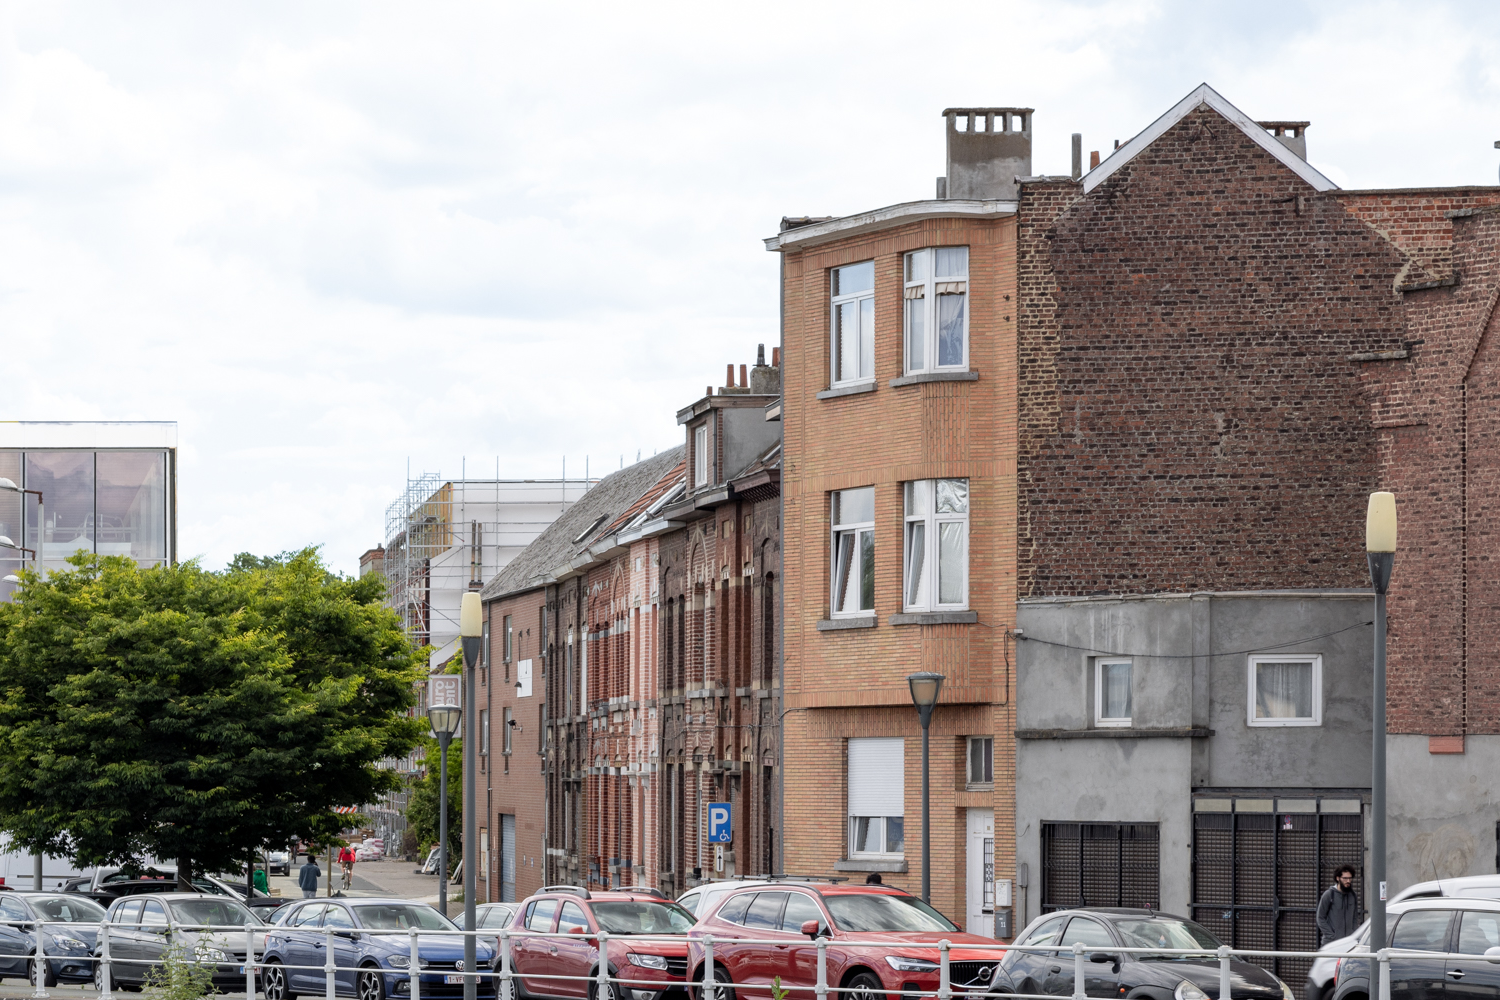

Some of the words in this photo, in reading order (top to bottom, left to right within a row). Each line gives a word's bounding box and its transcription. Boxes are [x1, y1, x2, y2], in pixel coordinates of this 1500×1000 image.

[435, 681, 445, 705] uro
[445, 681, 456, 705] ent
[711, 808, 729, 836] P
